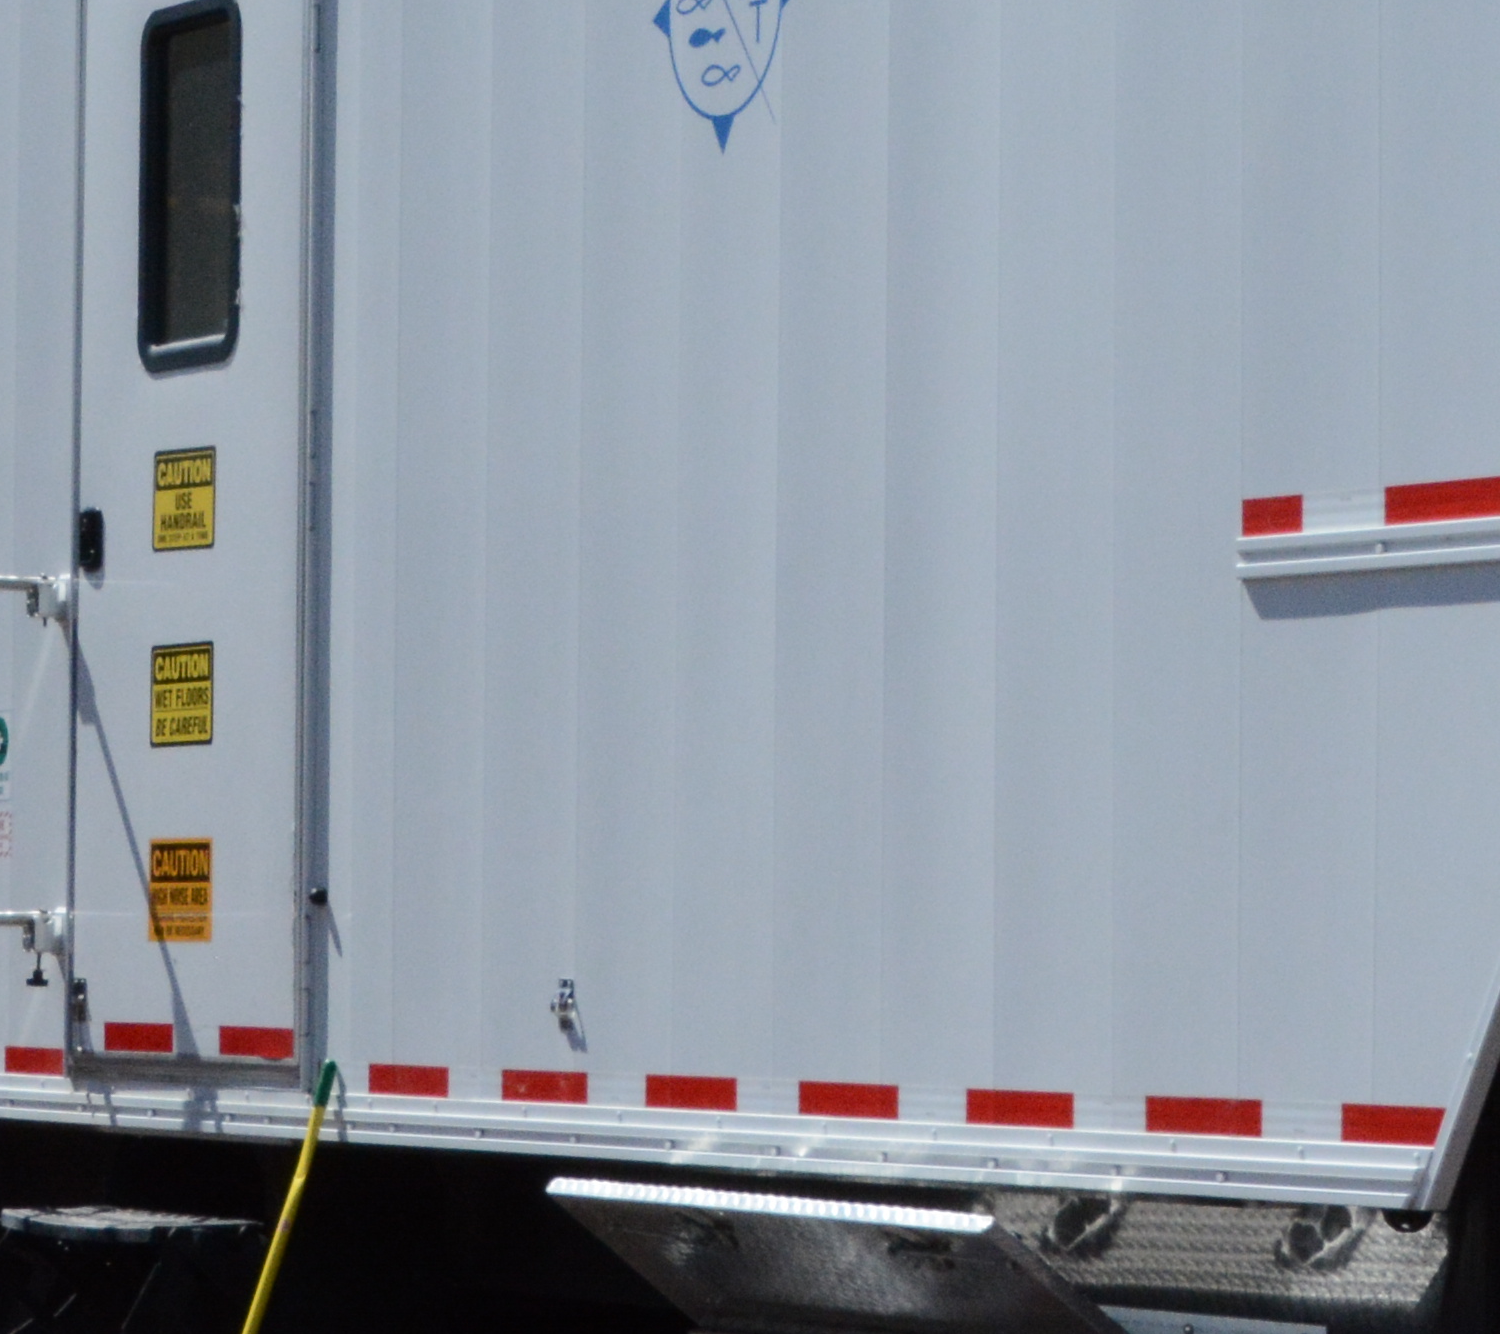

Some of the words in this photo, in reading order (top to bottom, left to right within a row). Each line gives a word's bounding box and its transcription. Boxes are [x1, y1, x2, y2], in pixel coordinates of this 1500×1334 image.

[157, 458, 212, 487] CAUTION
[174, 491, 193, 510] USE
[160, 511, 207, 531] HANDRAIL
[155, 653, 209, 681] CAUTION
[154, 689, 172, 708] WET
[176, 687, 211, 707] FLOORS
[155, 717, 167, 737] BE
[169, 715, 209, 736] CAREFUL
[153, 849, 209, 877] CAUTION
